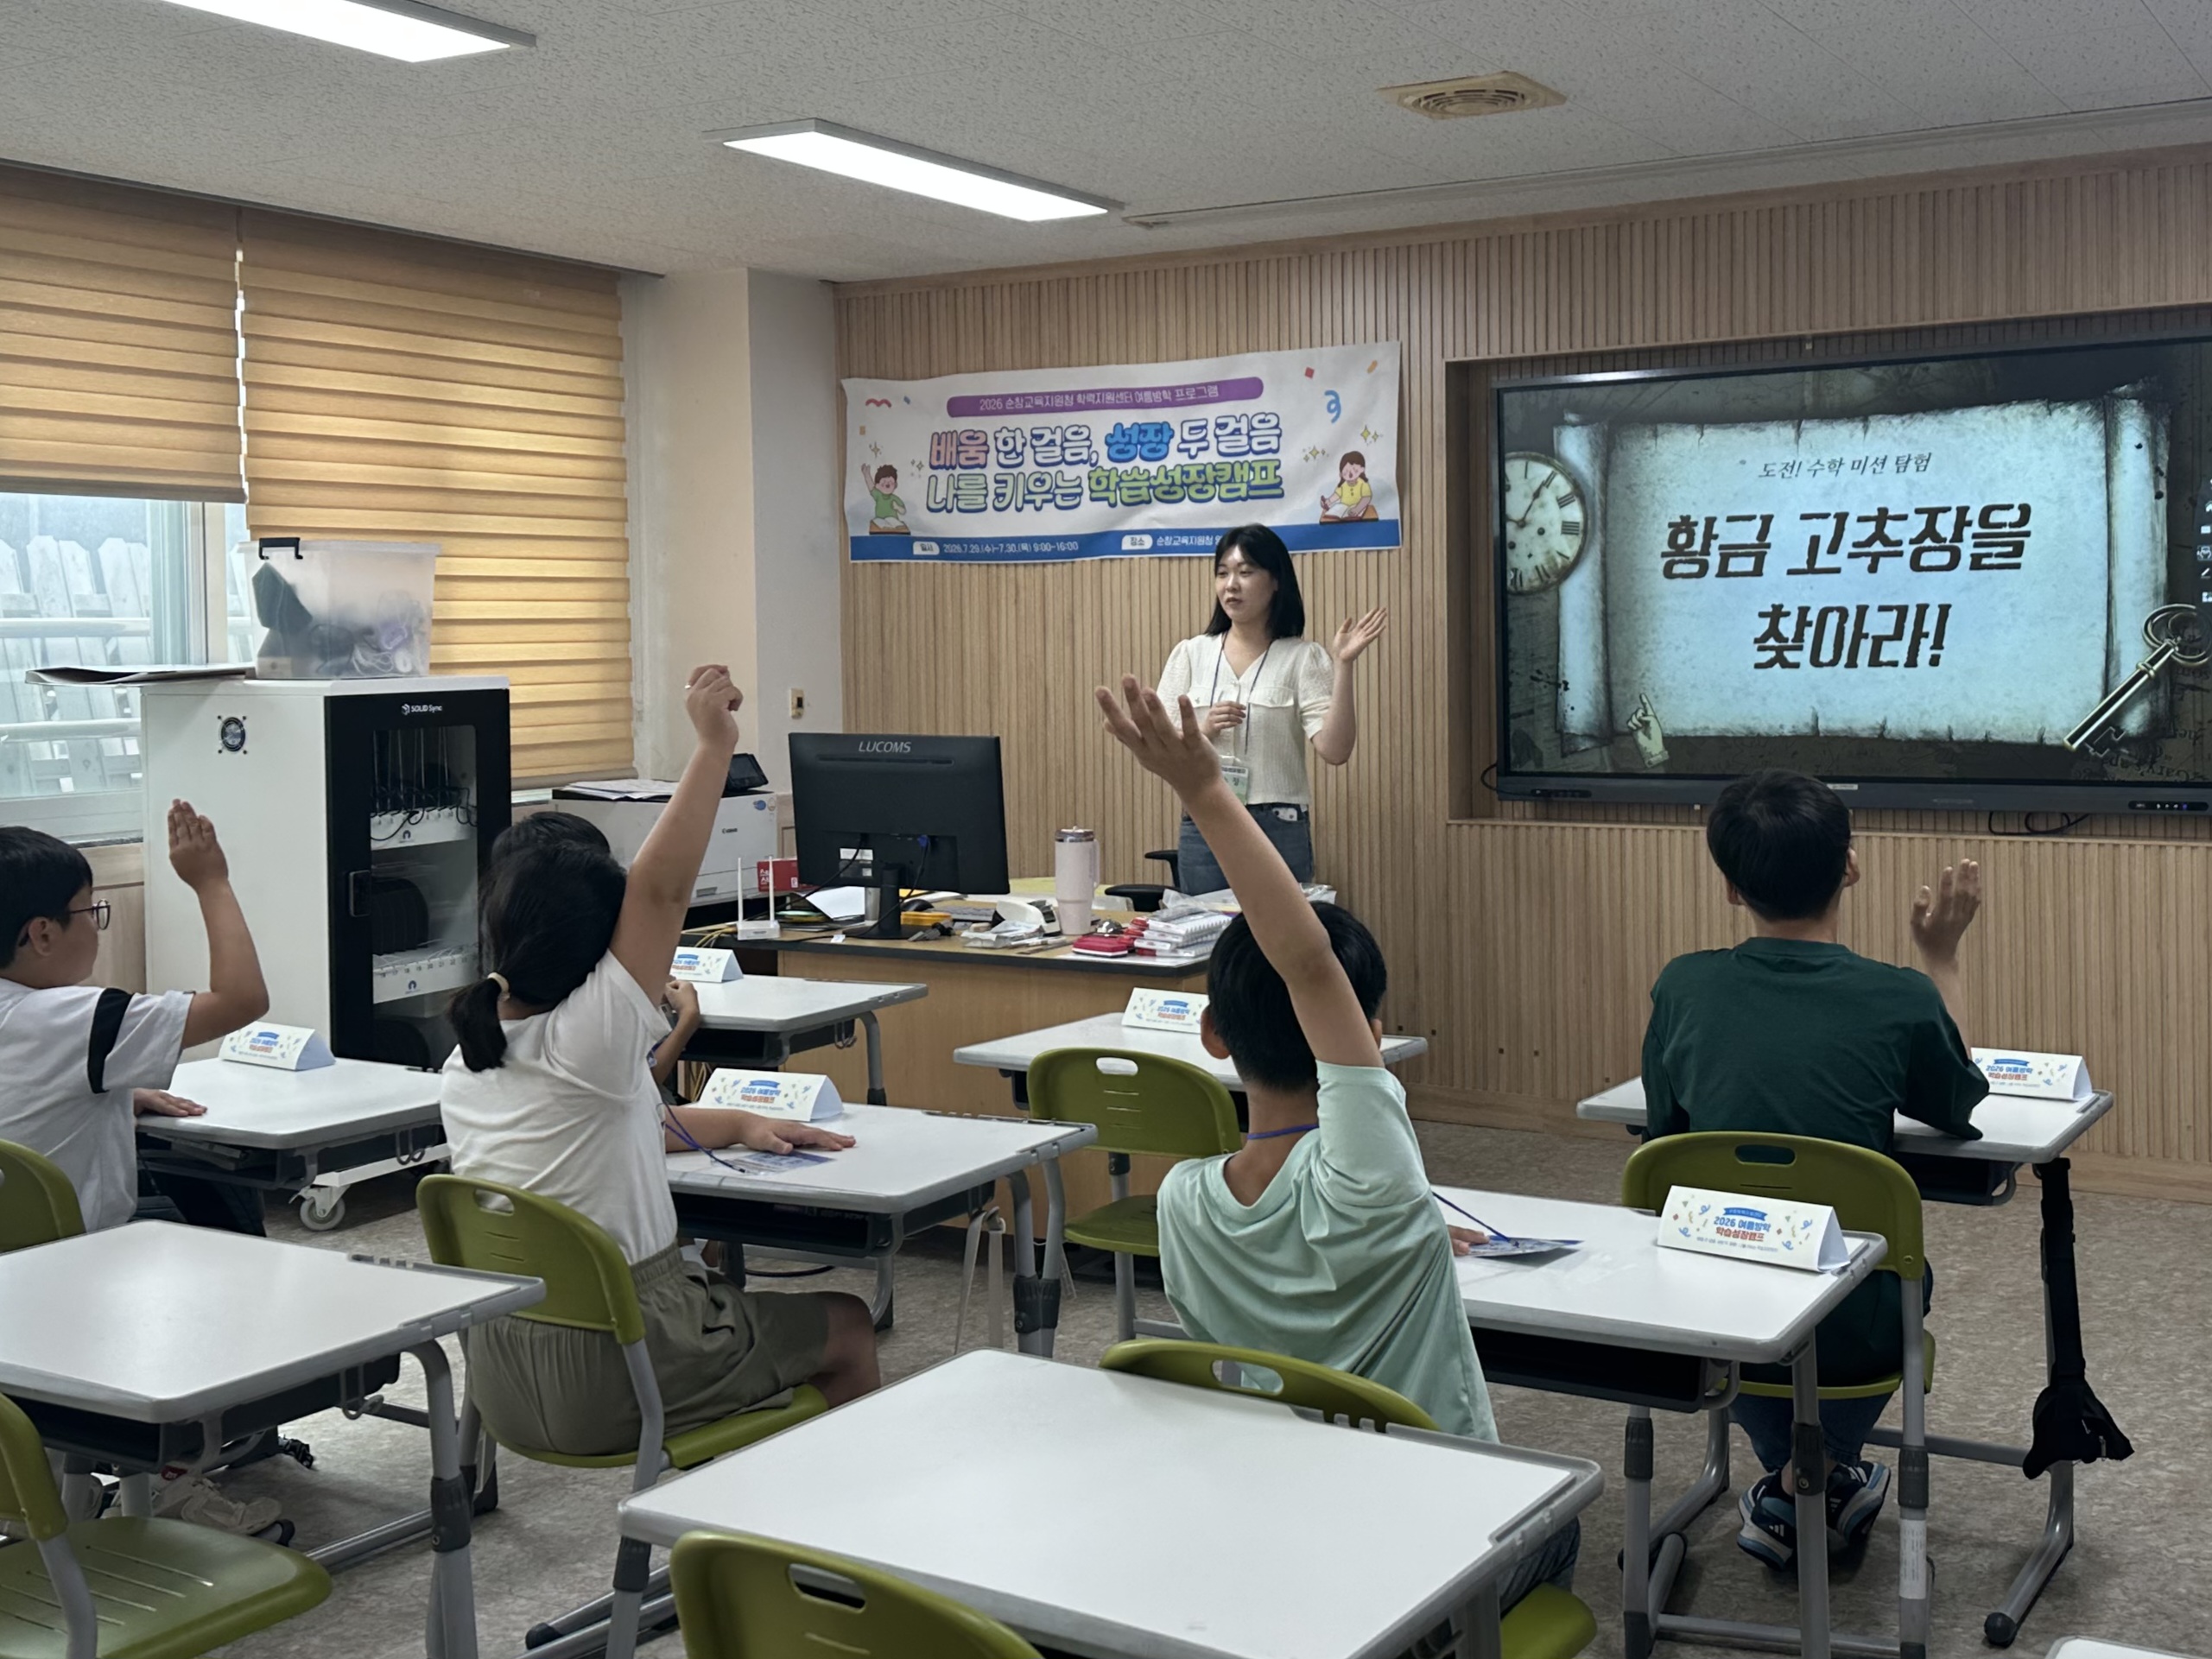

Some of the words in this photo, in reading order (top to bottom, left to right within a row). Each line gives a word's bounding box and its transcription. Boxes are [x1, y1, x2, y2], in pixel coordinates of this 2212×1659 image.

[979, 398, 1003, 411] 2026
[1005, 394, 1074, 409] 순창교육지원청
[1076, 390, 1133, 407] 학력지원센터
[1134, 389, 1172, 404] 여름방학
[1175, 384, 1220, 402] 프로그램
[929, 429, 989, 470] 배움
[994, 427, 1028, 468] 한
[1030, 424, 1099, 467] 걸음,
[1105, 421, 1175, 463] 성장
[1177, 418, 1209, 459] 두
[1214, 412, 1282, 455] 걸음
[1758, 459, 1802, 479] 도전!
[1806, 457, 1845, 478] 수학
[1850, 454, 1888, 475] 미션
[1894, 452, 1932, 473] 탐험
[926, 472, 988, 513] 나를
[992, 470, 1082, 512] 키우는
[1087, 459, 1284, 507] 학습성장캠프
[1130, 536, 1145, 546] 장소
[1157, 535, 1214, 546] 순창교육지원청
[1660, 514, 1774, 579] 황금
[1786, 503, 2032, 574] 고추장을
[1753, 603, 1952, 668] 찾아라!
[859, 741, 911, 753] LUCOMS
[1714, 1216, 1736, 1227] 2026
[1738, 1219, 1772, 1232] 여름방학
[1715, 1226, 1765, 1242] 학습성장캠프
